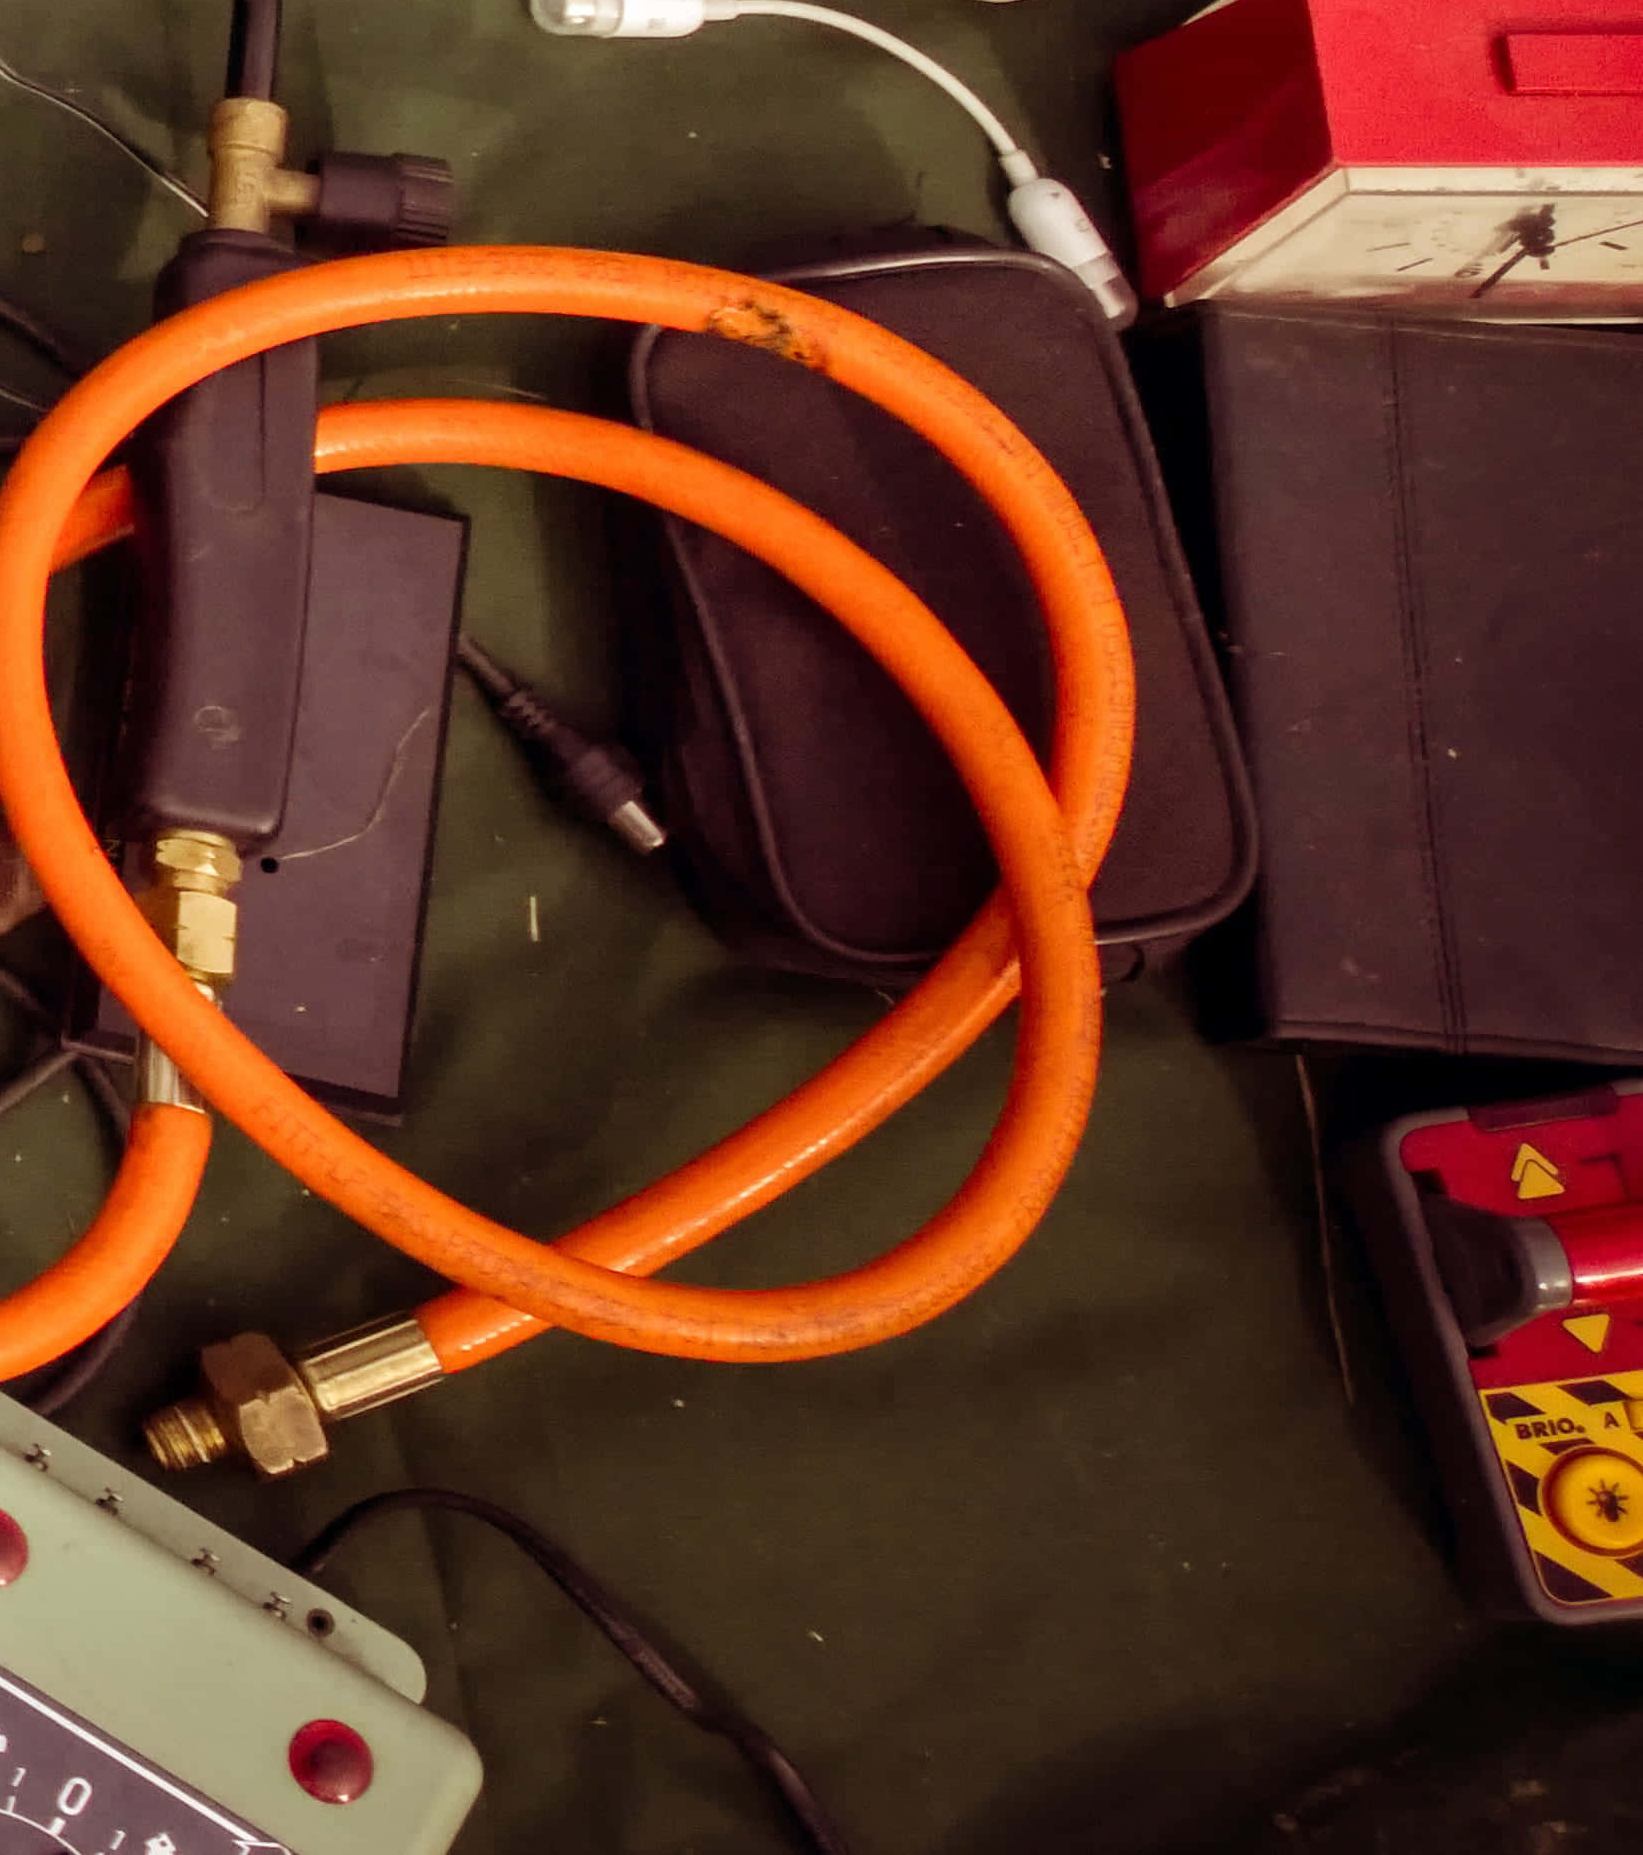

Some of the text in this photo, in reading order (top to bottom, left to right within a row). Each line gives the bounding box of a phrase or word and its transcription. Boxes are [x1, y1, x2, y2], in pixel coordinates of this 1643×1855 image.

[1514, 1417, 1576, 1443] BRIO
[10, 1765, 27, 1789] 1
[56, 1776, 95, 1815] 0
[110, 1828, 128, 1850] 1
